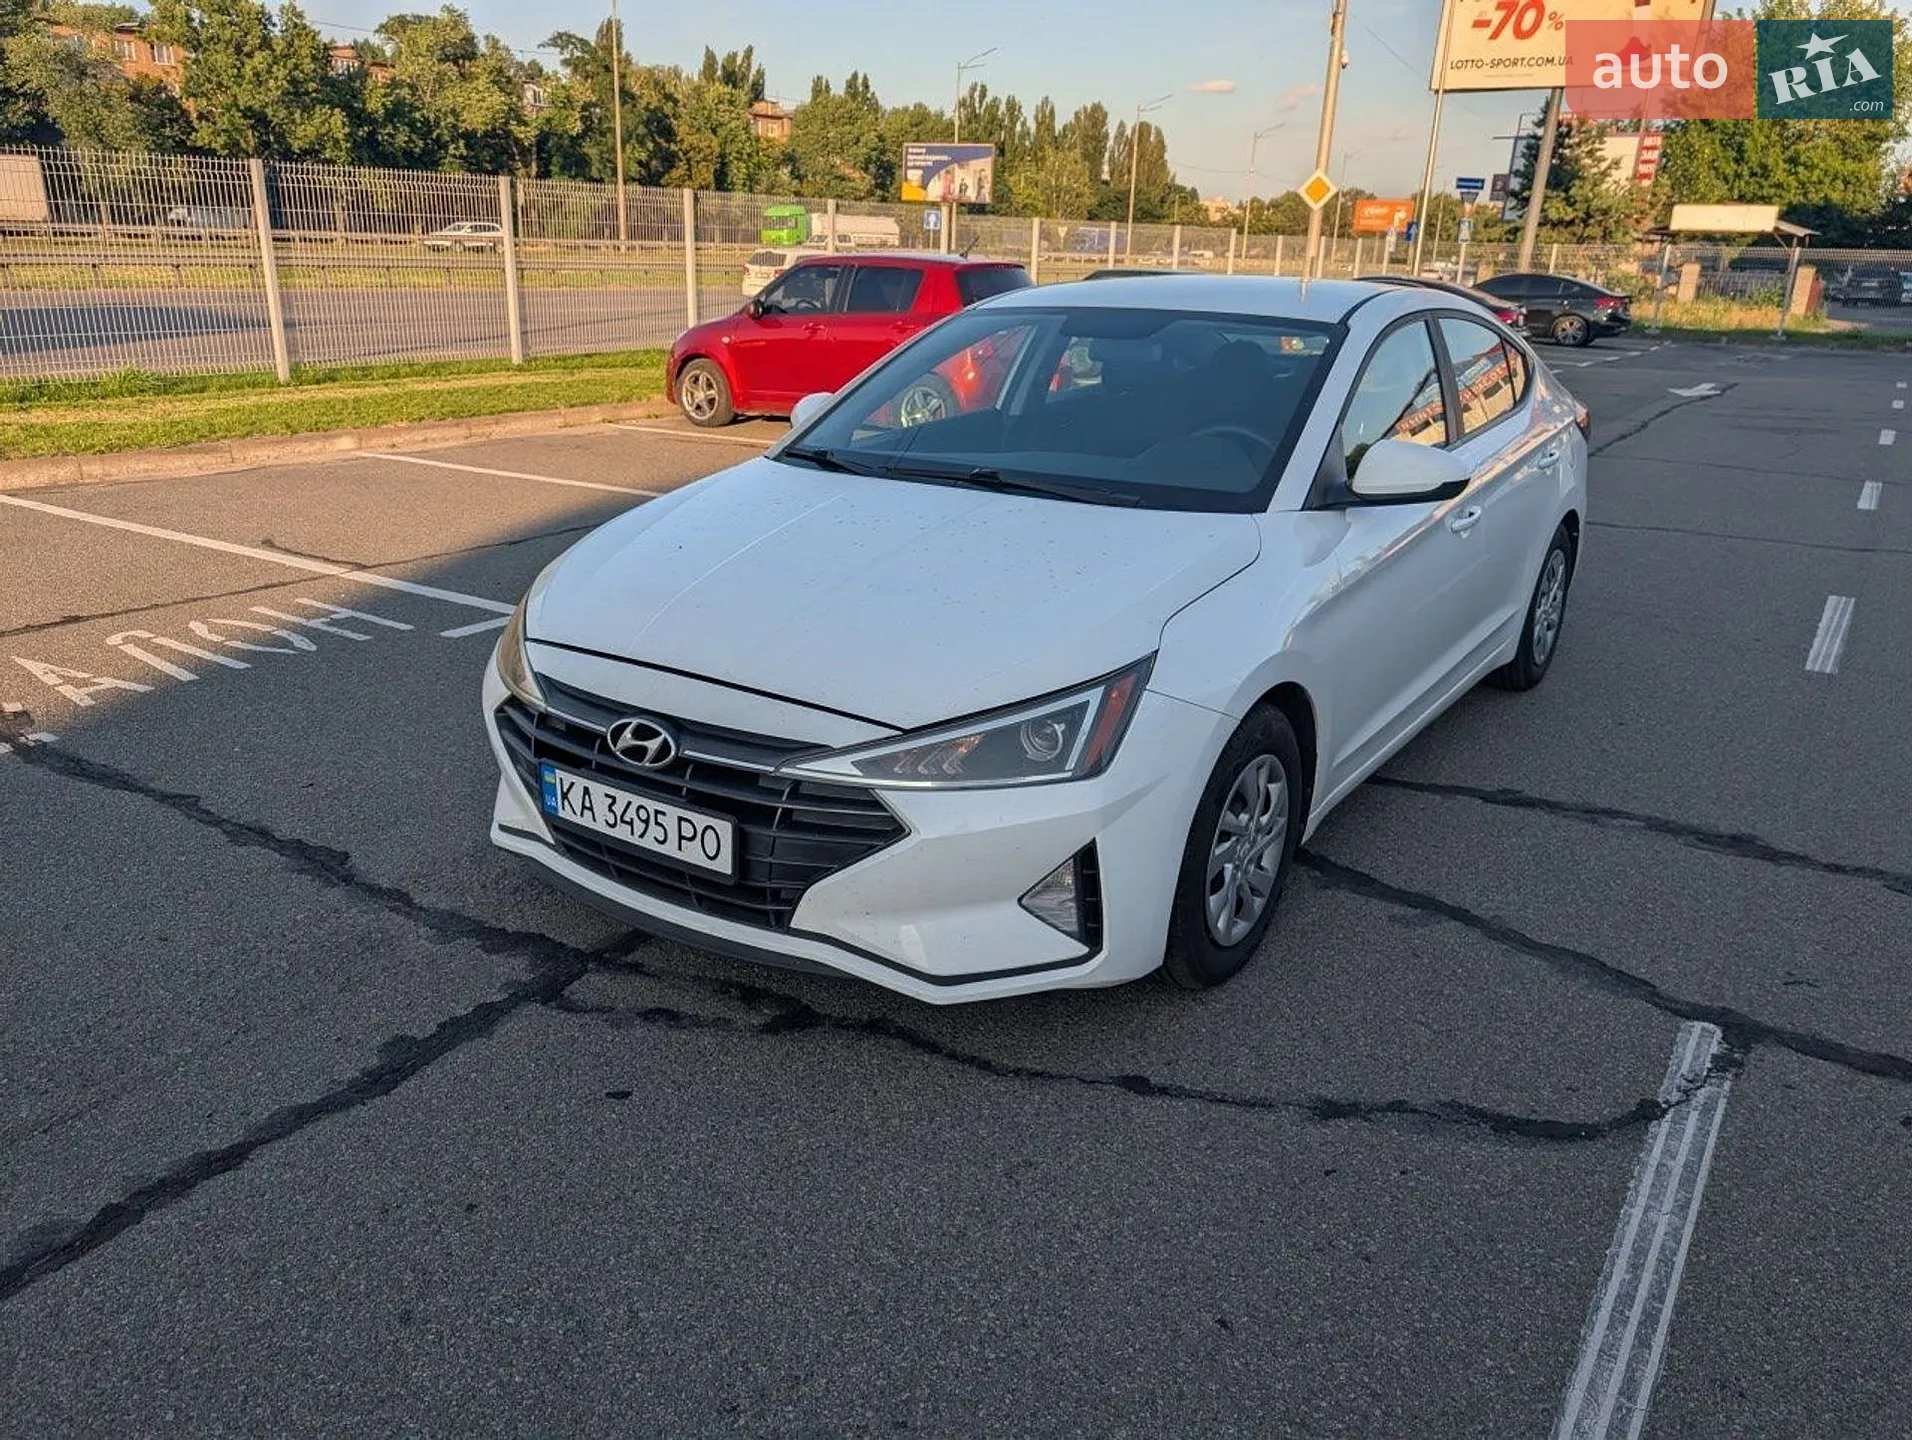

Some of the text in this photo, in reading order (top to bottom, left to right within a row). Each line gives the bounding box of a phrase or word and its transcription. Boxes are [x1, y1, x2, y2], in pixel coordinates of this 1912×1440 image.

[1450, 56, 1574, 70] LOTTO-SPORT.COM.UA
[559, 777, 721, 861] KA 3495 PO
